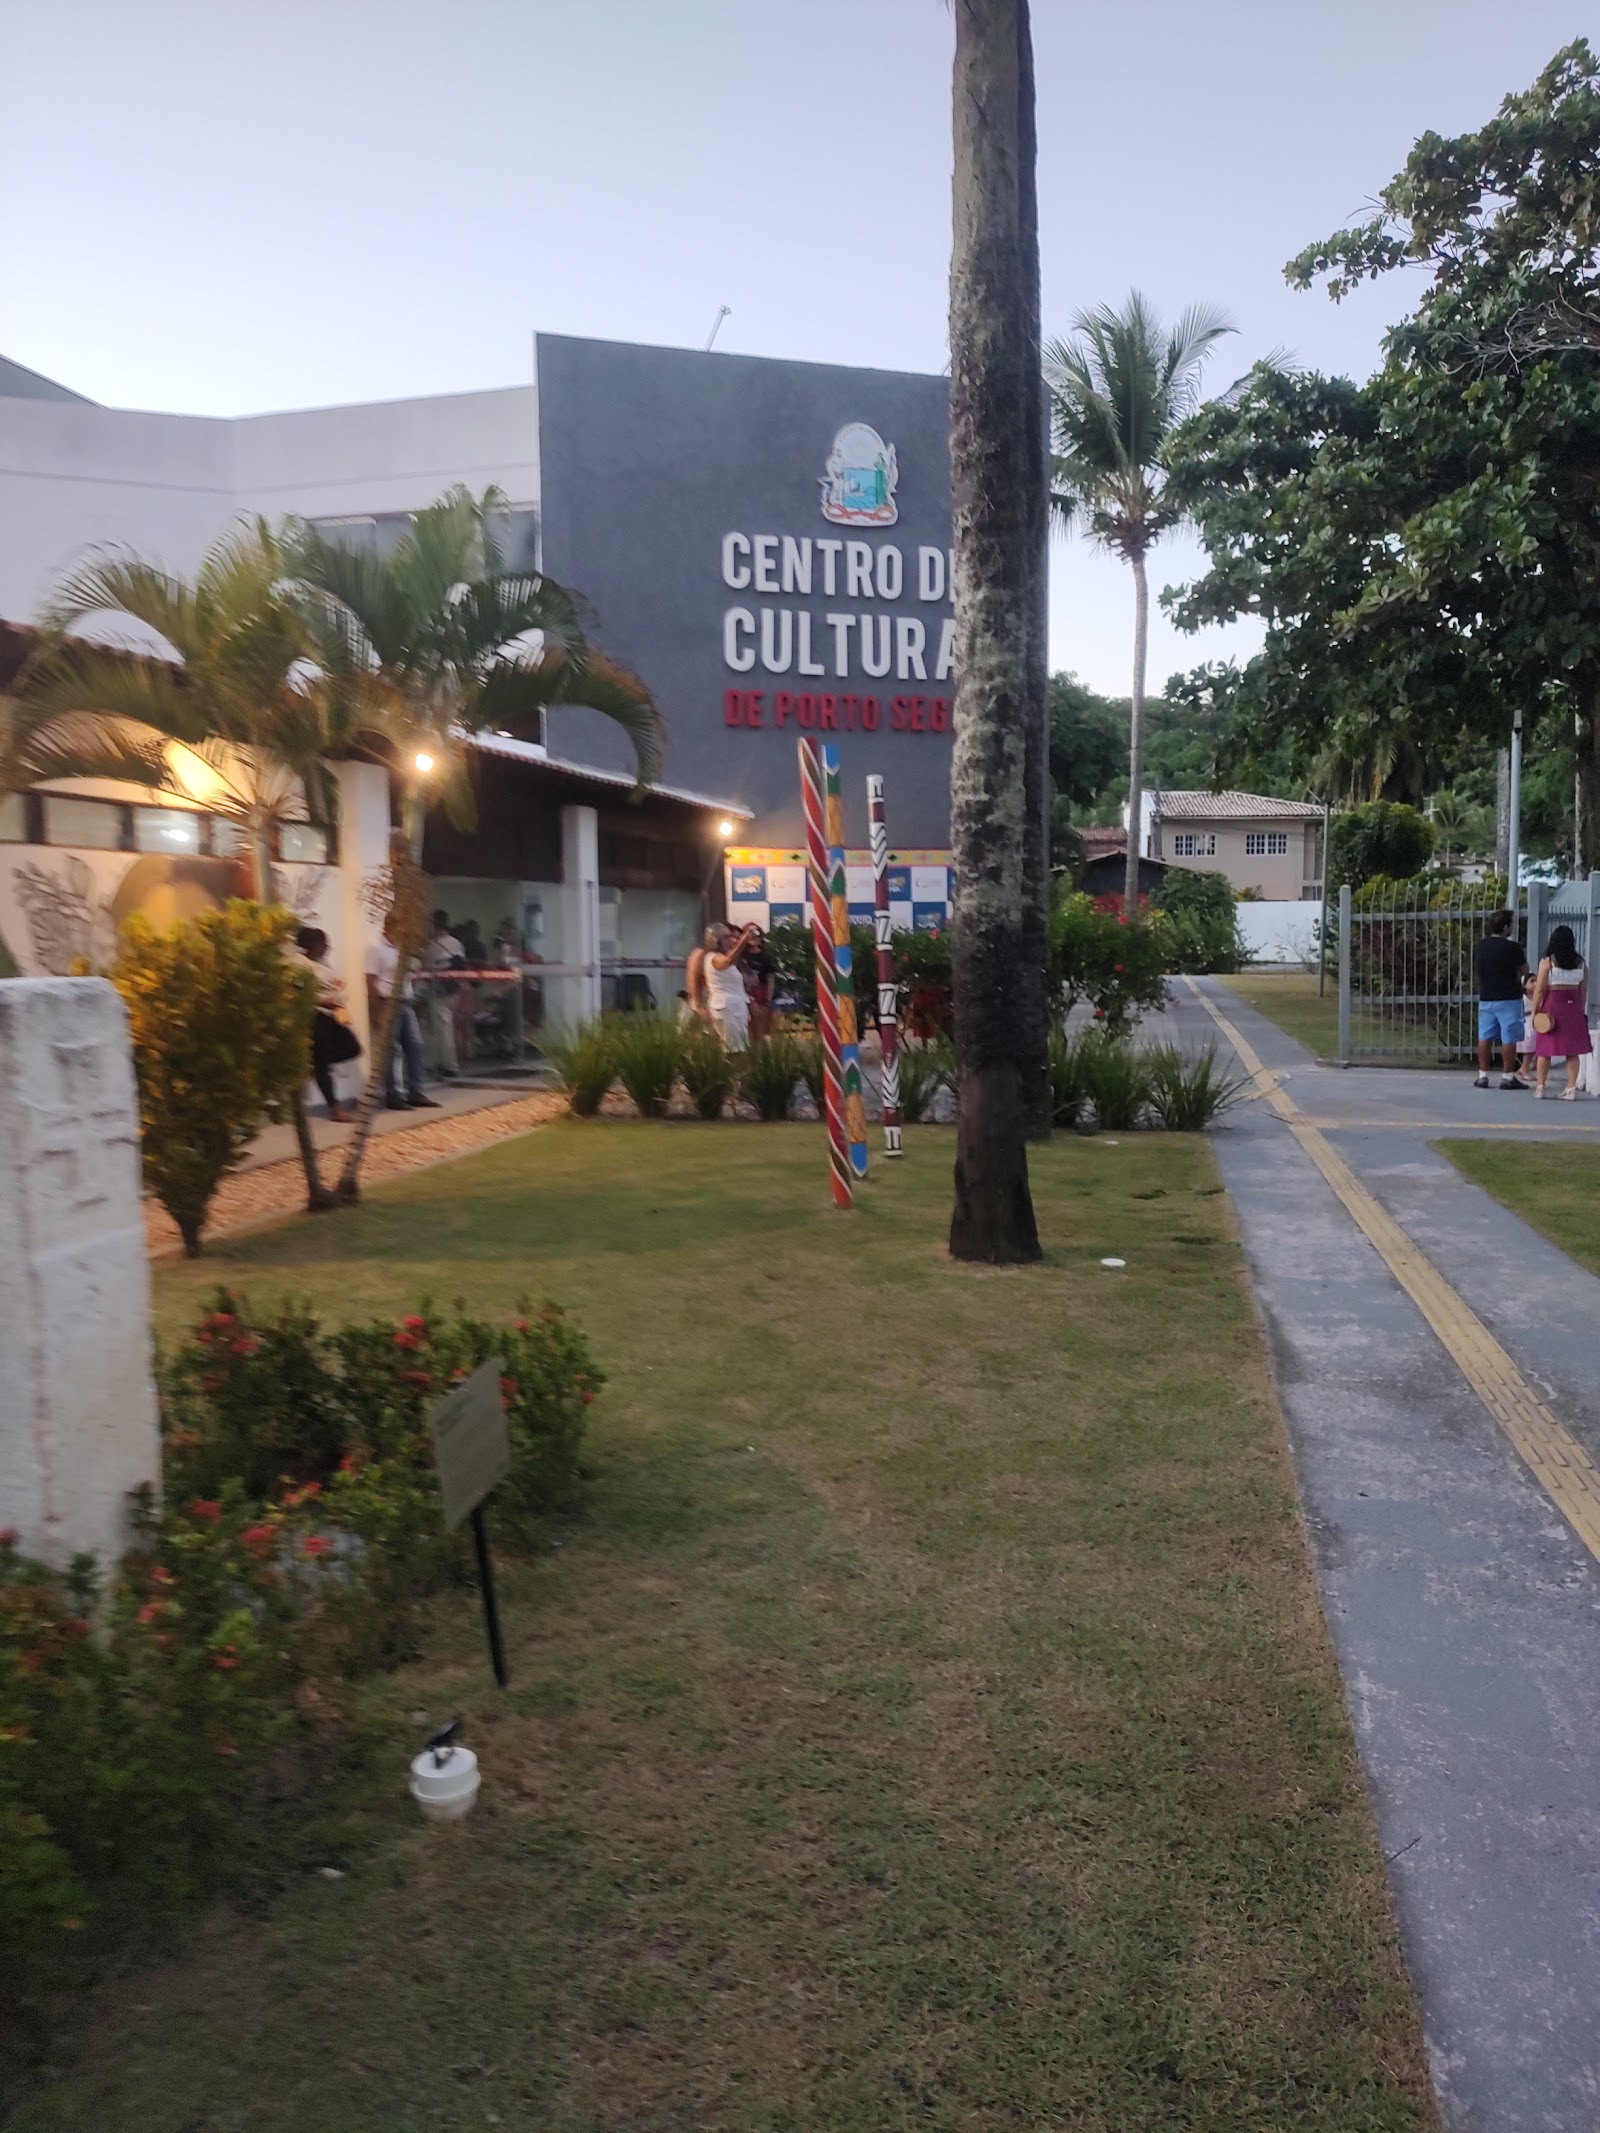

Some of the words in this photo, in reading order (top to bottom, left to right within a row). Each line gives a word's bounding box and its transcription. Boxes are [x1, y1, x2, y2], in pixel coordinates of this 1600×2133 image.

[722, 532, 903, 600] CENTRO
[724, 607, 956, 680] CULTURA
[725, 689, 764, 727] DE
[776, 691, 879, 731] PORTO
[890, 695, 949, 732] SEG
